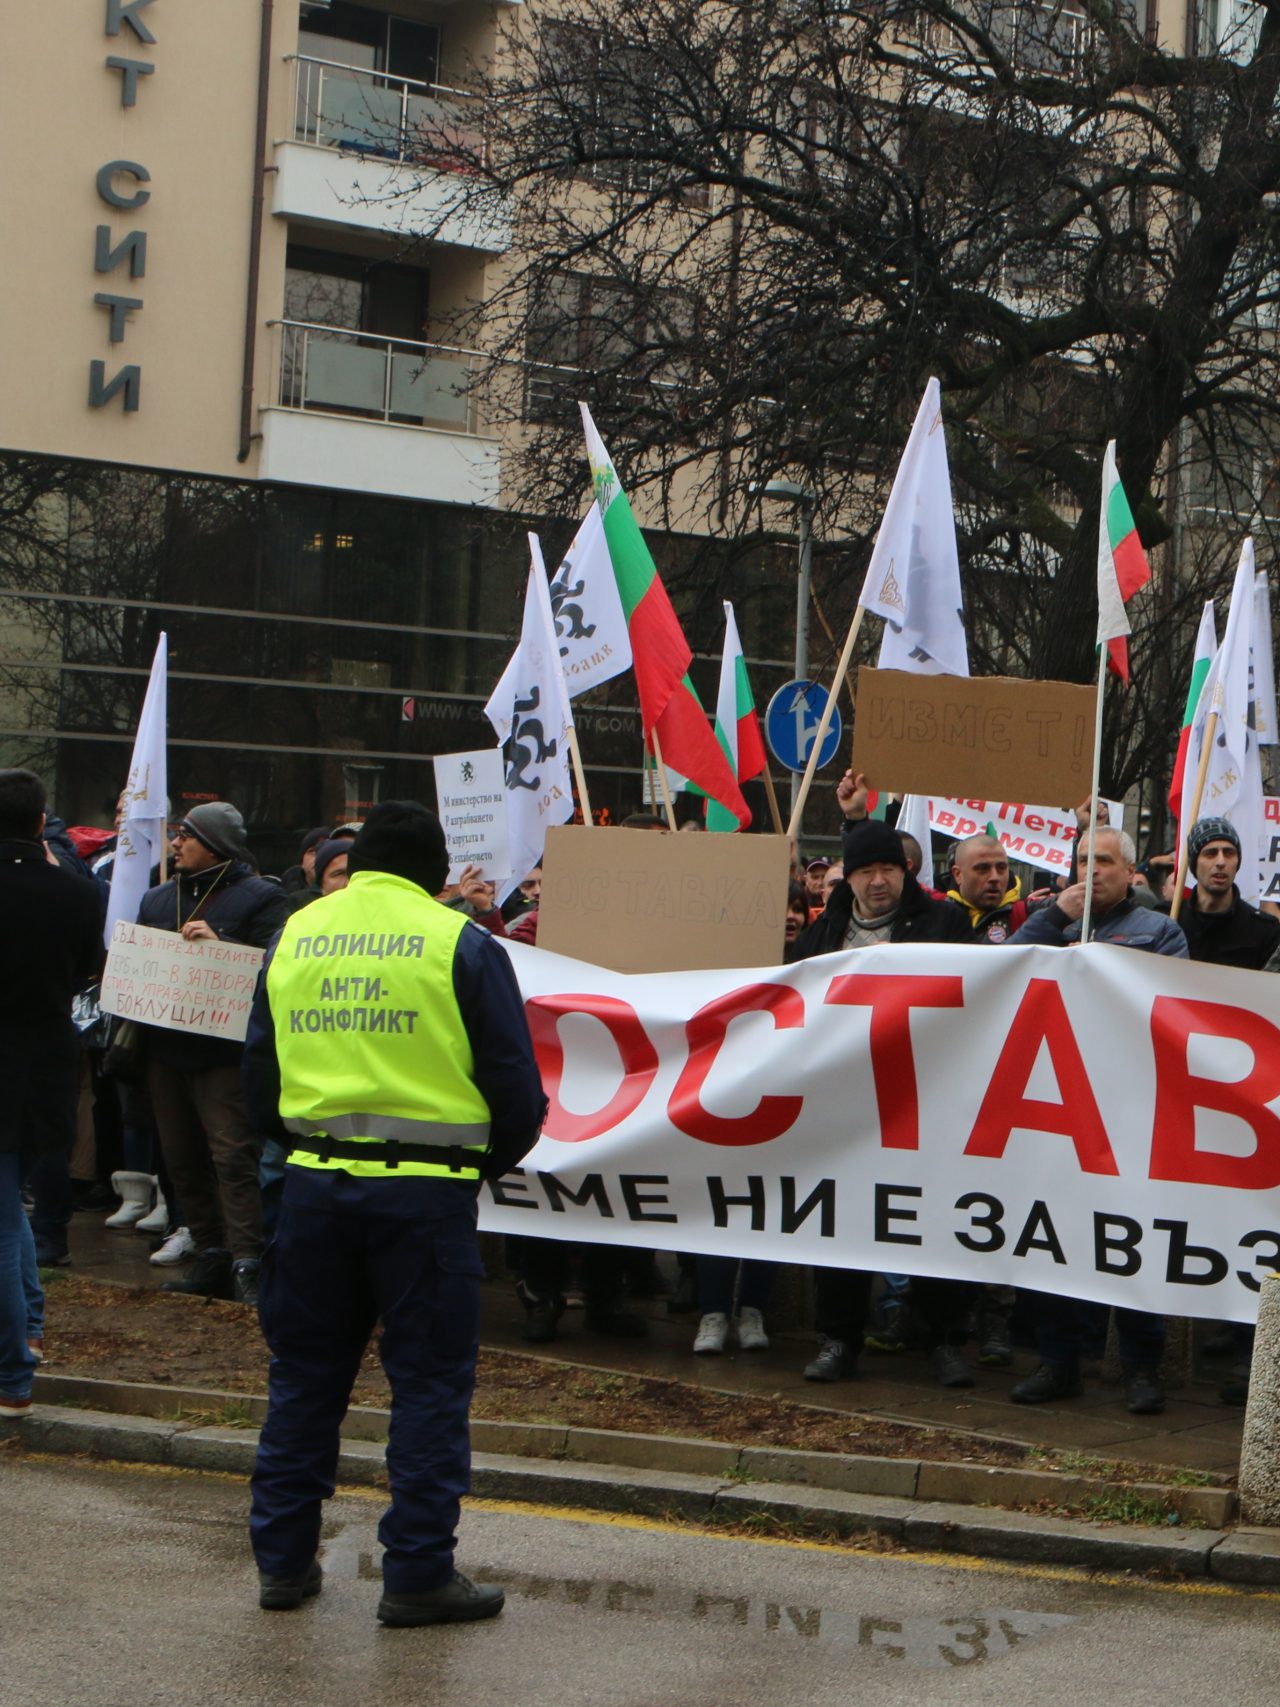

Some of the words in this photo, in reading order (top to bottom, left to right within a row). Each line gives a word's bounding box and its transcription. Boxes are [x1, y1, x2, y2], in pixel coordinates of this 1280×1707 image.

[88, 160, 152, 414] СИТИ
[294, 933, 425, 960] ПОЛИЦИЯ
[184, 967, 255, 994] ЗАТВОРА
[319, 977, 389, 1001] АНТИ-
[290, 1007, 419, 1034] КОНФЛИКТ
[705, 1175, 836, 1238] НИ
[874, 1183, 923, 1246] Е
[954, 1192, 1068, 1265] ЗА
